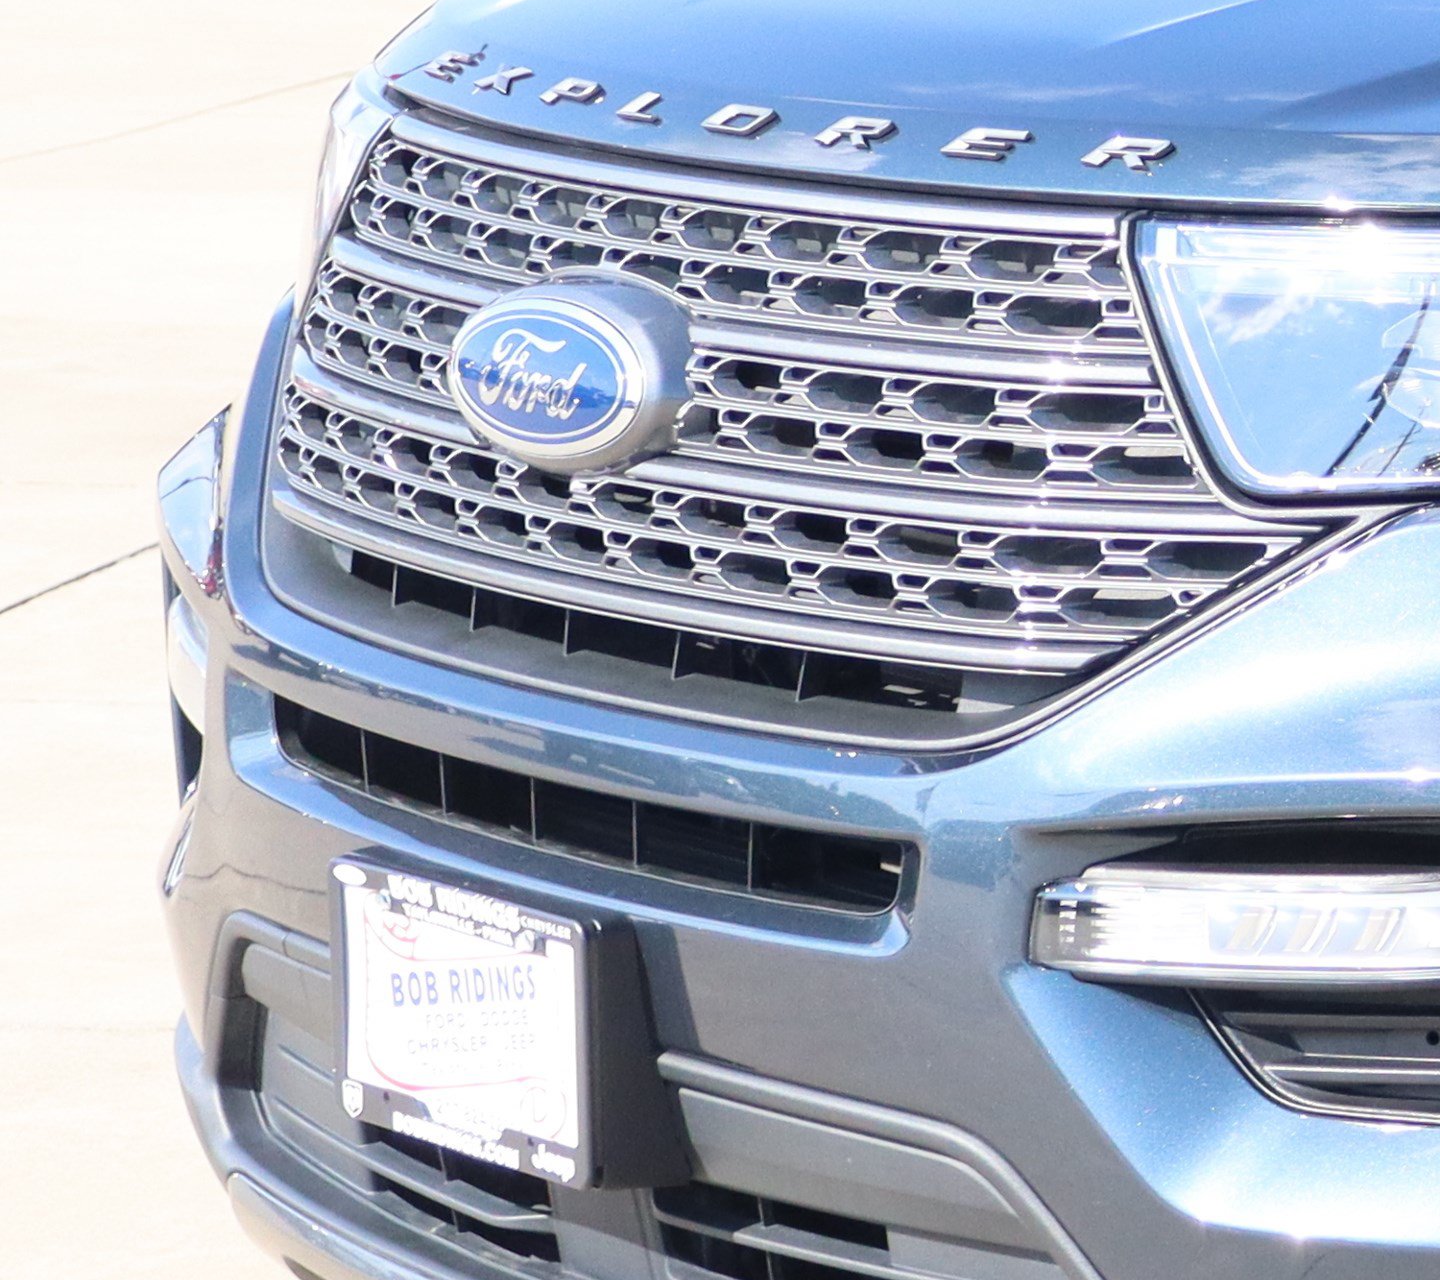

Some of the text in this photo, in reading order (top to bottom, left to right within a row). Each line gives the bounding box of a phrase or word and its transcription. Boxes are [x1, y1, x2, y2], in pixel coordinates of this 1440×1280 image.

[423, 43, 1177, 173] EXPLORER
[478, 326, 588, 420] Ford
[390, 964, 536, 1007] BOB RIDINGS
